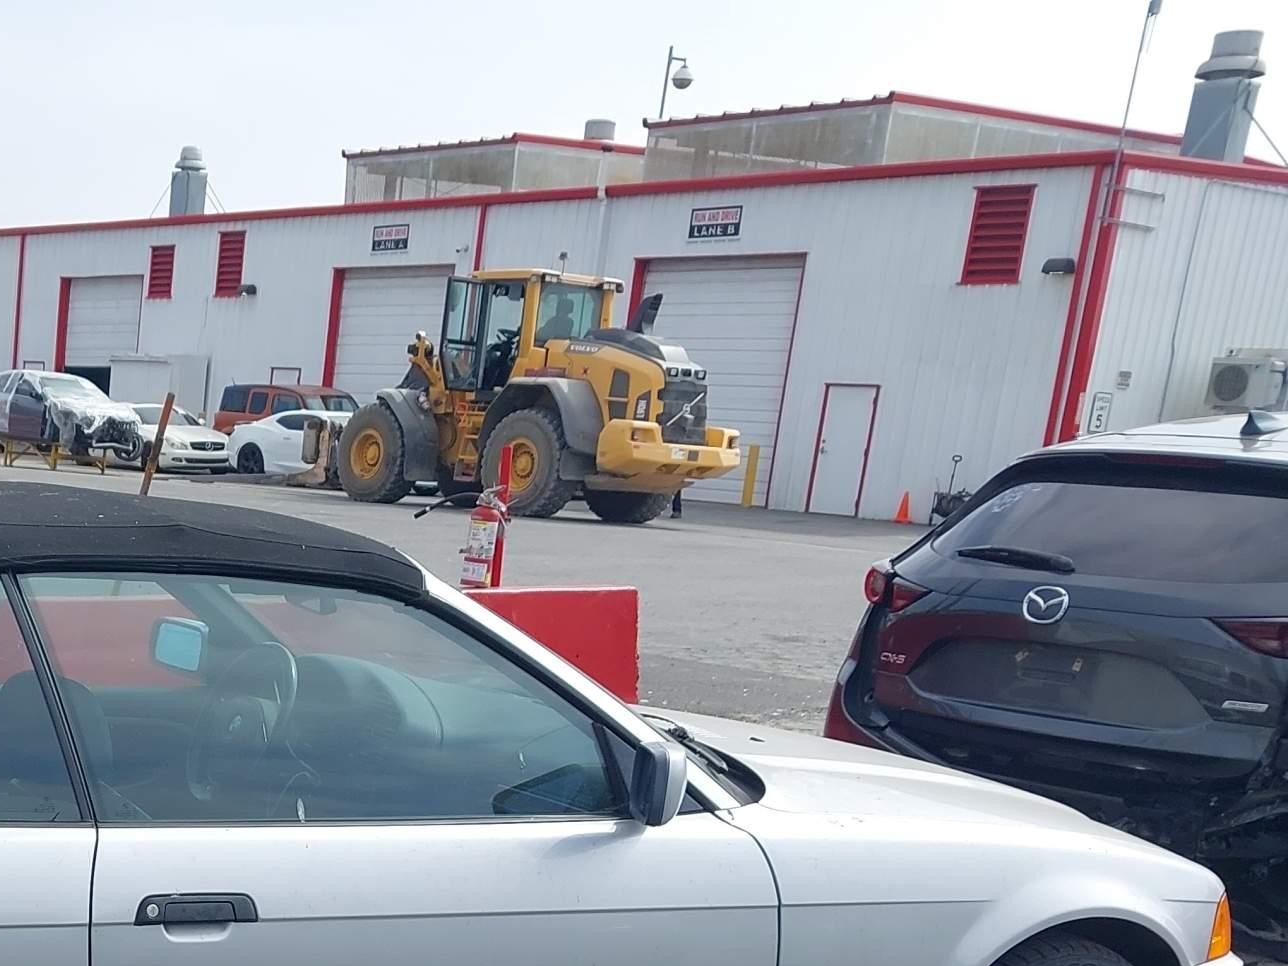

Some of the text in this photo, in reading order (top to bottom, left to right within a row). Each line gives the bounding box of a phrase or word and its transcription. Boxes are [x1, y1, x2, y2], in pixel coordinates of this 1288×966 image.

[694, 224, 734, 236] LANE B
[375, 240, 396, 250] LANE
[570, 344, 599, 352] VOLVO
[1095, 414, 1103, 429] 5
